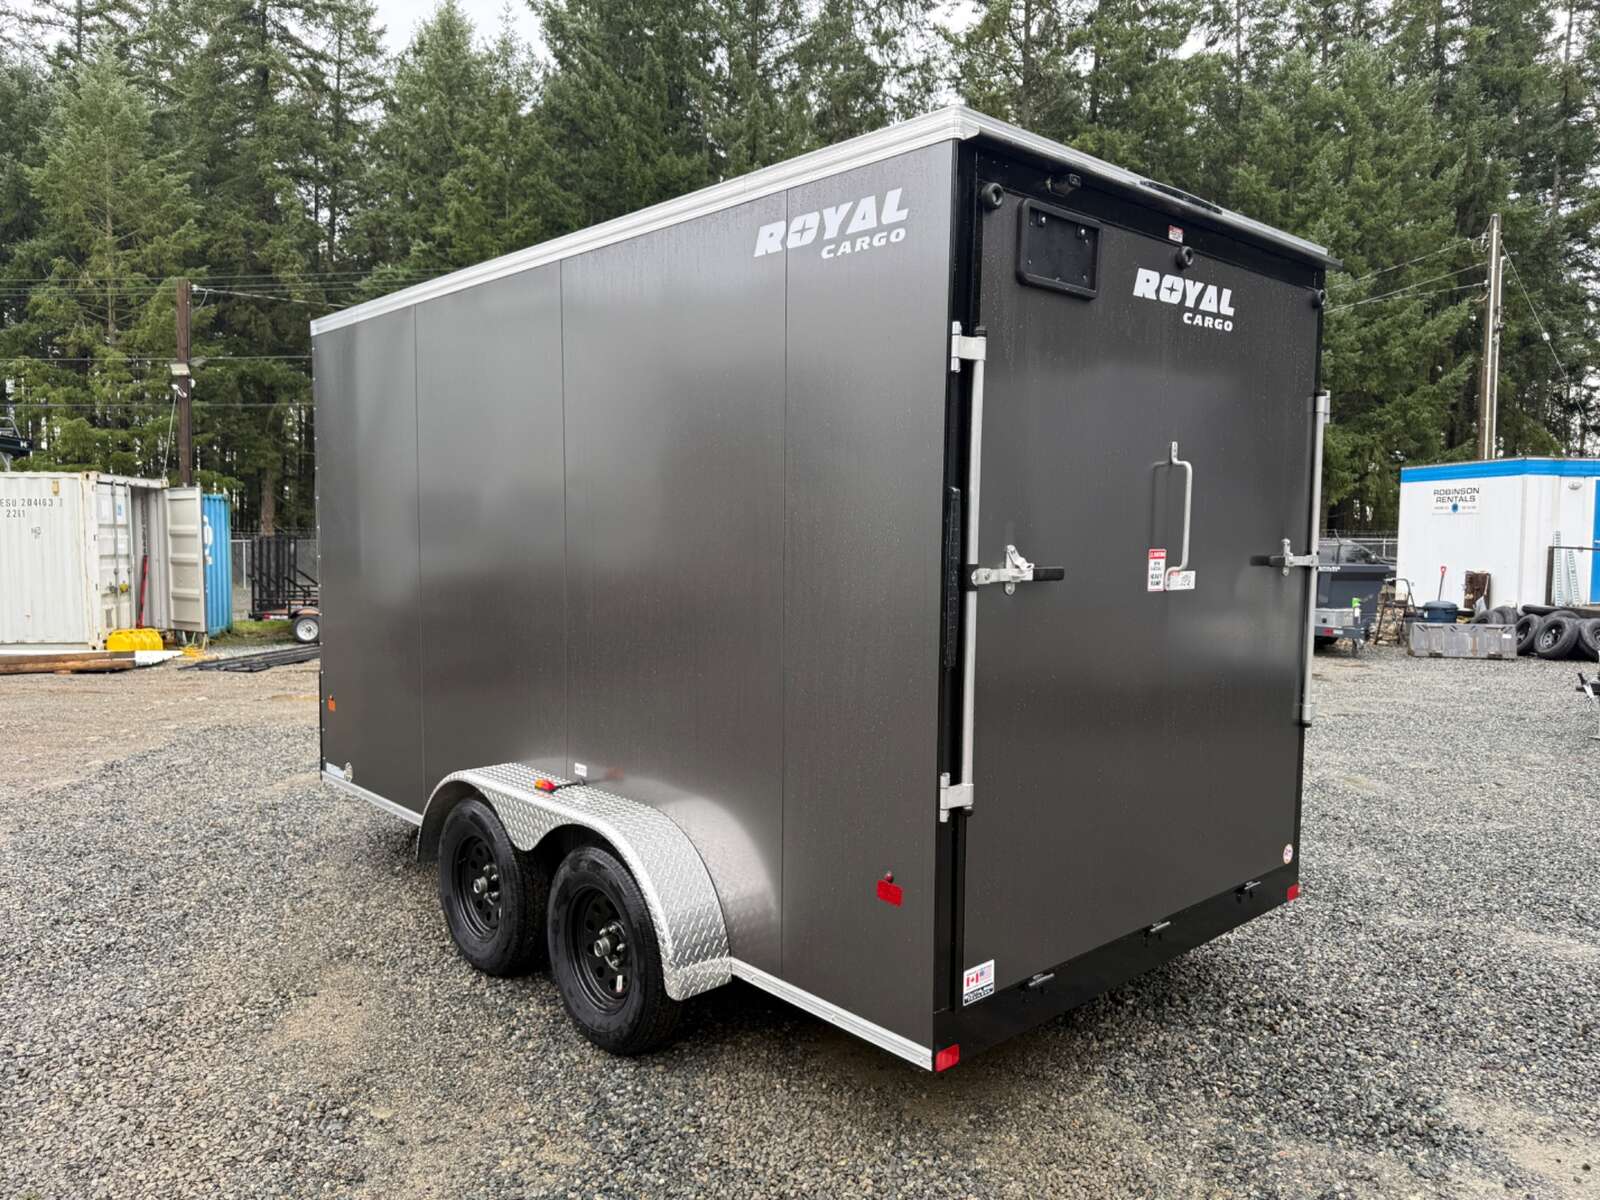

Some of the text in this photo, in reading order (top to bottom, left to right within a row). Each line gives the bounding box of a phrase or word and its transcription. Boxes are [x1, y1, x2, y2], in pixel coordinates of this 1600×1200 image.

[753, 187, 909, 258] ROYAL
[820, 227, 906, 260] CARGO
[1132, 267, 1235, 317] ROYAL
[1182, 312, 1233, 332] CARGO
[1433, 487, 1480, 495] ROBINSON
[1435, 495, 1476, 503] RENTALS
